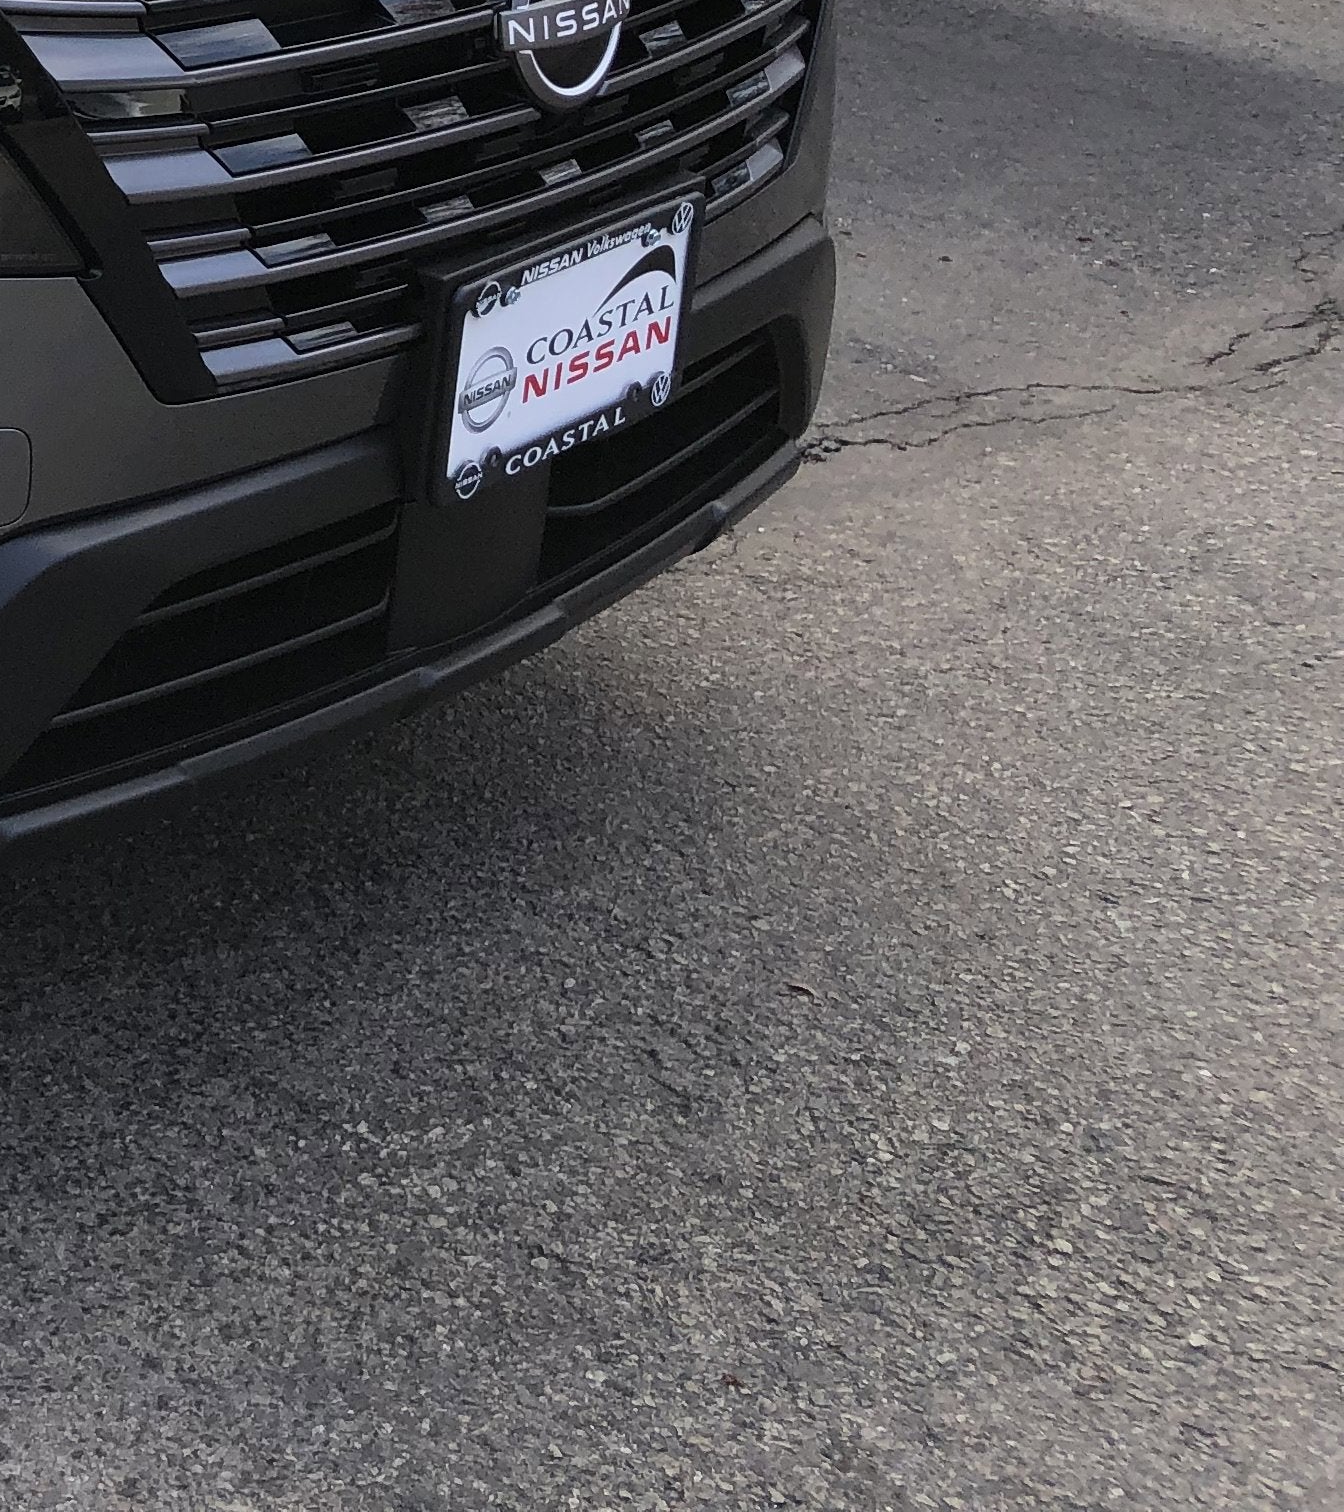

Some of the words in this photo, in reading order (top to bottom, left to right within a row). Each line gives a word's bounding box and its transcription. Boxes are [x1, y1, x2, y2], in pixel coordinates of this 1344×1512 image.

[520, 246, 584, 286] NISSAN
[525, 284, 675, 365] COASTAL
[462, 372, 512, 406] NISSAN
[521, 315, 672, 404] NISSAN
[505, 407, 627, 475] COASTAL
